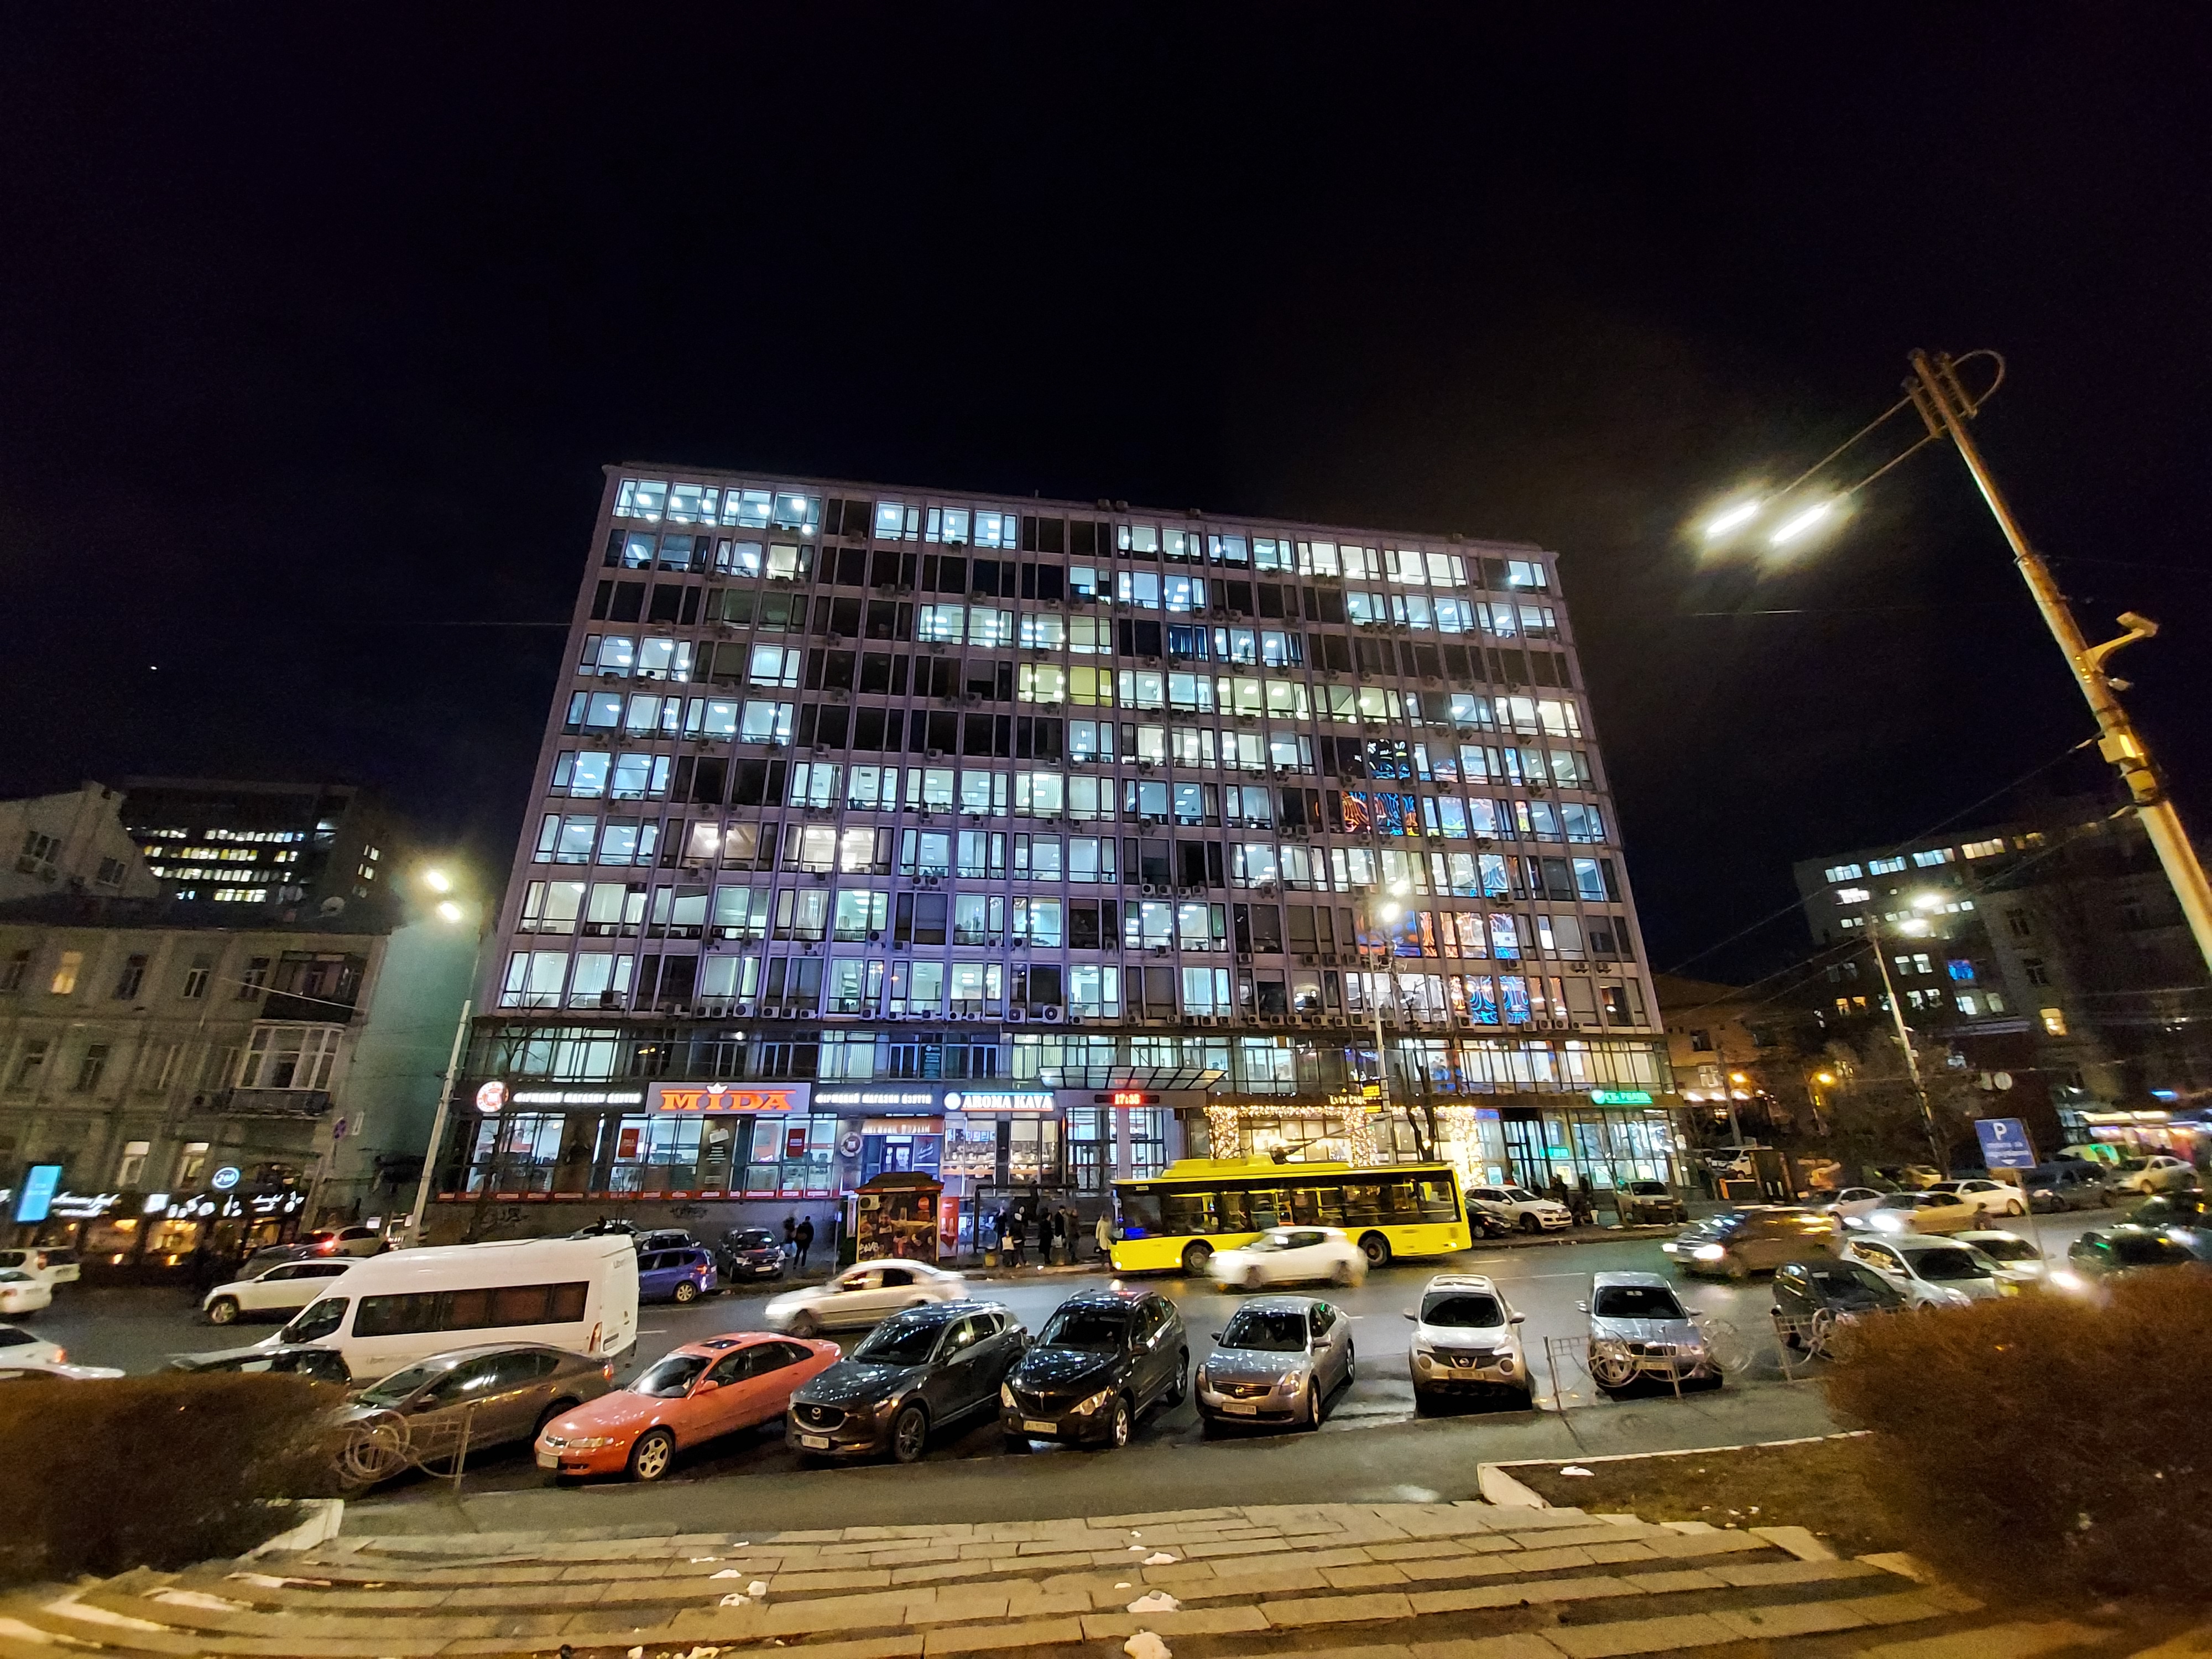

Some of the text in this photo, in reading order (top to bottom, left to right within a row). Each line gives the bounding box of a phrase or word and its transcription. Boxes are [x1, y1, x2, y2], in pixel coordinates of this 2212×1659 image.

[564, 1093, 606, 1103] МАГАЗИН
[660, 1094, 792, 1110] MIDA
[862, 1094, 899, 1104] МАГАЗИН
[962, 1095, 1053, 1109] AROMA KAVA
[1993, 1123, 2007, 1140] P
